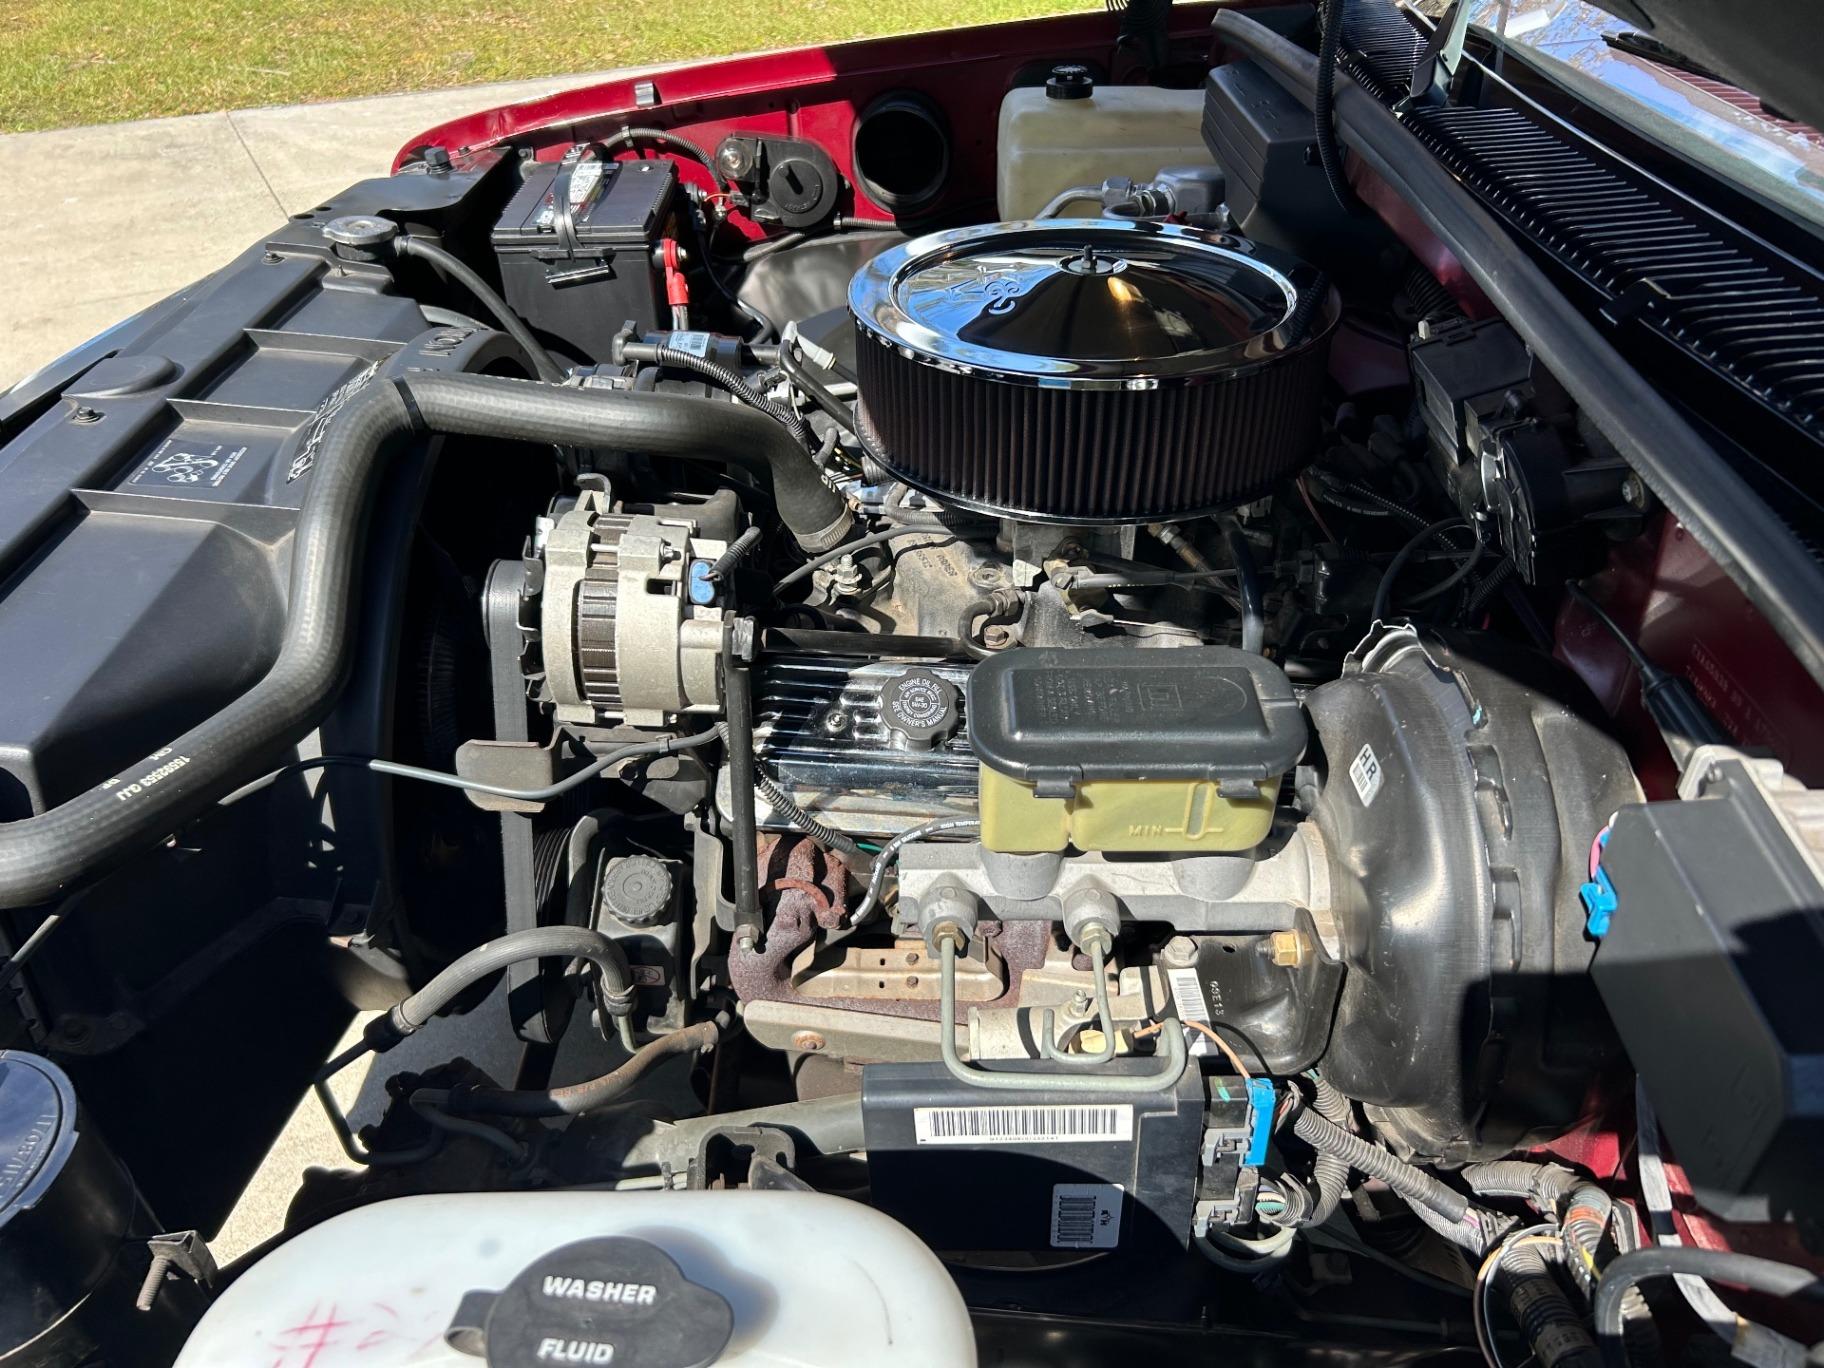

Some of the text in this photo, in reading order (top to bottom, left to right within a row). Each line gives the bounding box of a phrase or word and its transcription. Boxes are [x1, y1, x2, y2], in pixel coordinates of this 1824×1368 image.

[898, 677, 942, 695] ENGINE OIL FILL
[892, 701, 948, 728] SEE OWNER'S MANUAL
[1360, 747, 1377, 781] HR
[1128, 824, 1162, 837] MIN
[542, 1275, 657, 1305] WASHER
[537, 1337, 616, 1365] FLUID
